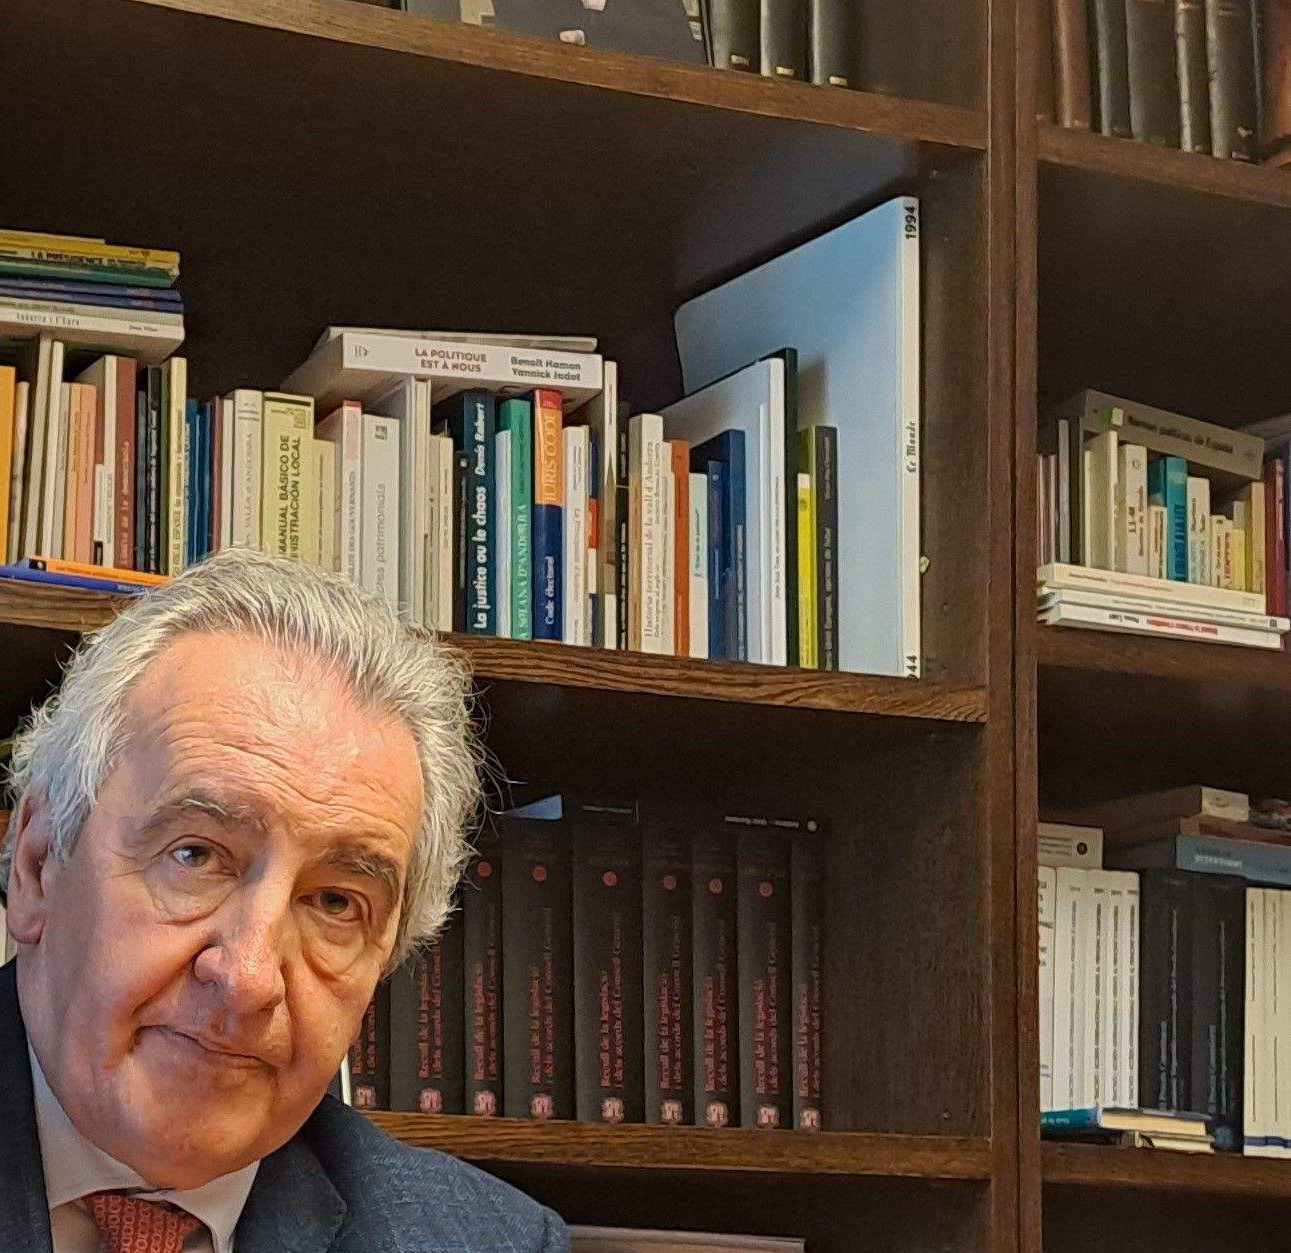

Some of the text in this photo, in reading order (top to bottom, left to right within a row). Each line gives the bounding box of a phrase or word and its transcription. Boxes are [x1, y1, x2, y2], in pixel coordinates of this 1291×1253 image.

[904, 205, 917, 240] 1994
[414, 347, 488, 364] LA POLITIQUE
[420, 358, 439, 369] EST
[451, 361, 482, 374] NOUS
[545, 359, 582, 371] Hamon
[511, 367, 582, 382] Yannick Jadot
[291, 437, 300, 477] LOCAL
[474, 403, 485, 476] Denis Robert
[905, 420, 917, 457] Monde
[277, 435, 289, 555] MANUAL BÁSICO DE
[542, 459, 558, 502] JURIS
[517, 504, 528, 577] D'ANDORRA
[643, 528, 653, 541] de
[472, 486, 491, 629] La justice ou le chaos
[517, 580, 528, 628] SOLANA
[545, 600, 554, 625] Code
